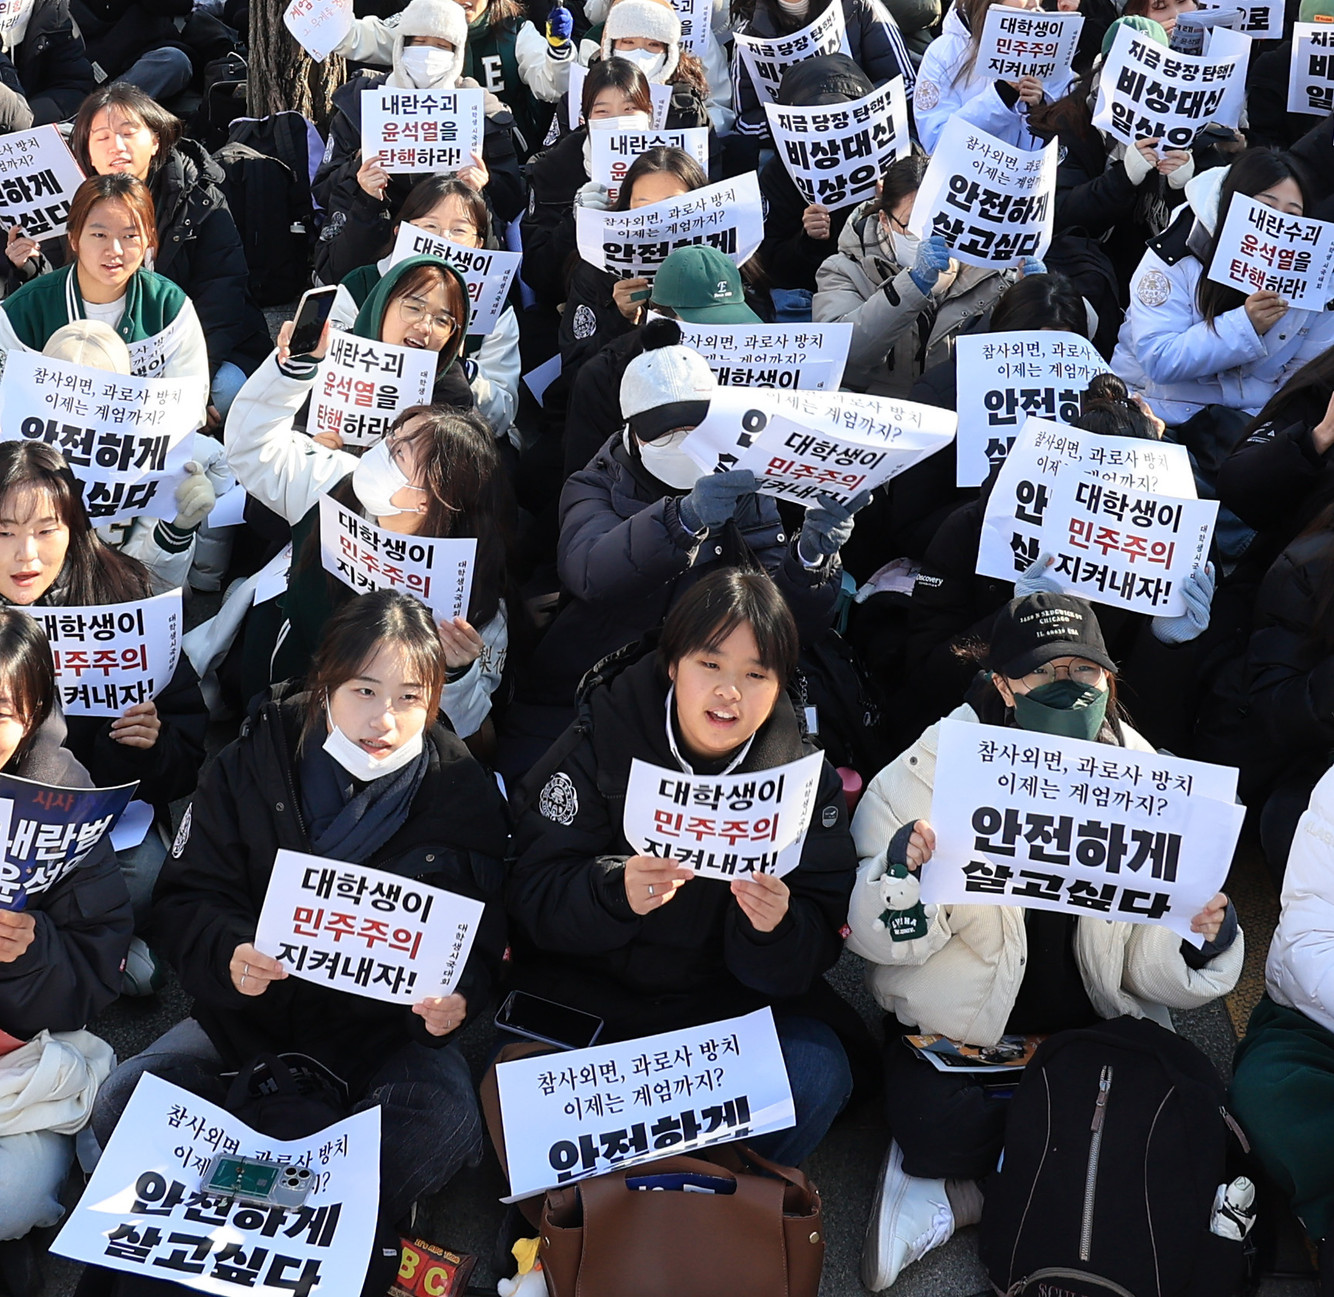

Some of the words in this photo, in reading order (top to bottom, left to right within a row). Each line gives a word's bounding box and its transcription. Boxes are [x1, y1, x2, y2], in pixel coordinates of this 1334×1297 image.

[999, 16, 1065, 38] 대학생이
[481, 54, 505, 93] E
[1116, 66, 1227, 125] 비상대신
[381, 95, 459, 116] 내란수괴
[777, 110, 809, 133] 지금
[812, 107, 847, 130] 당장
[853, 91, 892, 120] 탄핵!
[381, 123, 458, 144] 윤석열을
[784, 124, 899, 170] 비상대신
[1247, 206, 1323, 247] 내란수괴
[329, 337, 405, 380] 내란수괴
[981, 341, 1047, 364] 참사외면,
[996, 361, 1045, 379] 이제는
[322, 370, 401, 410] 윤석열을
[783, 428, 888, 471] 대학생이
[1073, 480, 1183, 535] 대학생이
[915, 572, 944, 584] Discovery
[1053, 551, 1173, 608] 지켜내자!
[975, 739, 1070, 777] 참사외면,
[1077, 755, 1145, 787] 과로사
[1150, 767, 1193, 798] 방치
[657, 772, 787, 813] 대학생이
[995, 768, 1063, 804] 이제는
[1069, 779, 1171, 818] 계엄까지?
[650, 805, 781, 846] 민주주의
[970, 804, 1185, 884] 안전하게
[299, 866, 433, 925] 대학생이
[960, 860, 1172, 919] 살고싶다
[292, 906, 422, 963] 민주주의
[275, 941, 419, 998] 지켜내자!
[536, 1058, 629, 1098] 참사외면,
[629, 1043, 694, 1081] 과로사
[696, 1031, 742, 1062] 방치
[561, 1086, 629, 1123] 이제는
[631, 1062, 726, 1109] 계엄까지?
[546, 1095, 752, 1183] 안전하게
[102, 1221, 323, 1297] 살고싶다
